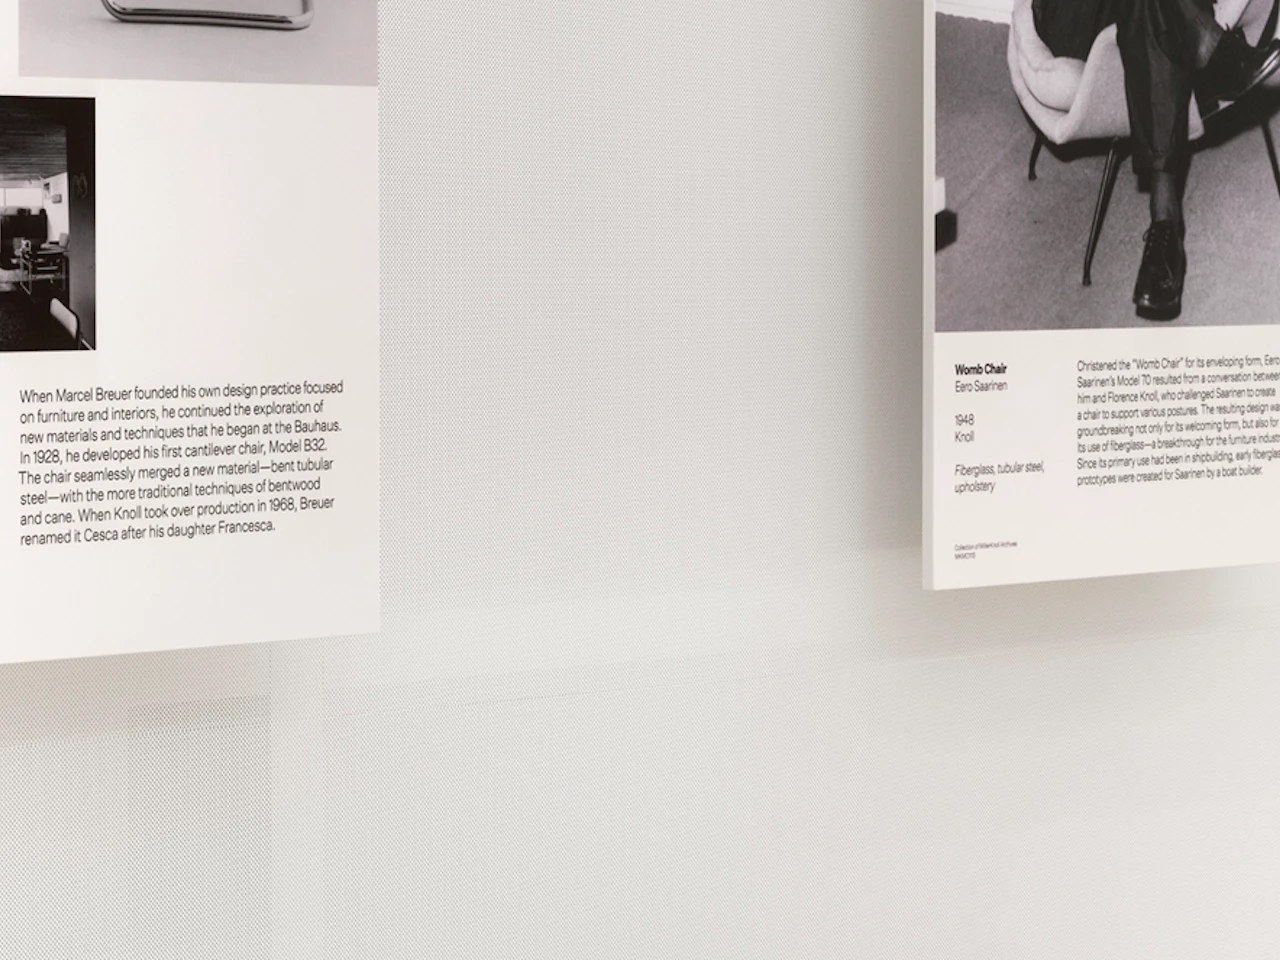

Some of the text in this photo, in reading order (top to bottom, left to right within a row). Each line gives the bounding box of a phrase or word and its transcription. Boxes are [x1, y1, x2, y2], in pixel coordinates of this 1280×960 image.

[954, 362, 1007, 375] Womb Chair
[1076, 359, 1117, 372] Christened
[1118, 359, 1131, 371] the
[1184, 356, 1195, 368] for
[1196, 357, 1205, 368] its
[1205, 355, 1244, 369] enveloping
[1244, 354, 1263, 367] form,
[1264, 353, 1280, 366] Eero
[954, 379, 1008, 393] Eero Saarinen
[1116, 374, 1140, 386] Model
[1140, 373, 1151, 386] 70
[1152, 373, 1182, 385] resulted
[1182, 372, 1199, 384] from
[1200, 374, 1207, 384] a
[1206, 372, 1251, 383] conversation
[19, 379, 343, 403] When Marcel Breuer founded his own design practice focused
[1076, 386, 1276, 404] him and Florence Knoll, who challenged Saarinen to create
[19, 398, 324, 424] on furniture and interiors, he continued the exploration of
[954, 413, 974, 426] 1948
[20, 418, 342, 444] new materials and techniques that he began at the Bauhaus.
[954, 430, 974, 442] Knoll
[20, 436, 327, 465] In 1928, he developed his first cantilever chair, Model B32.
[17, 470, 41, 484] The
[43, 469, 71, 484] chair
[73, 465, 135, 482] seamlessly
[137, 463, 181, 481] merged
[182, 466, 190, 477] a
[192, 465, 215, 476] new
[296, 456, 334, 472] tubular
[954, 460, 1044, 478] Fiberglass, tubular steel,
[85, 487, 104, 502] the
[106, 488, 136, 500] more
[137, 482, 192, 499] traditional
[194, 480, 254, 497] techniques
[254, 478, 266, 493] of
[267, 475, 320, 492] bentwood
[954, 480, 996, 495] upholstery
[19, 495, 335, 526] and cane. When Knoll took over production in 1968, Breuer
[20, 519, 275, 546] renamed it Cesca after his daughter Francesca.
